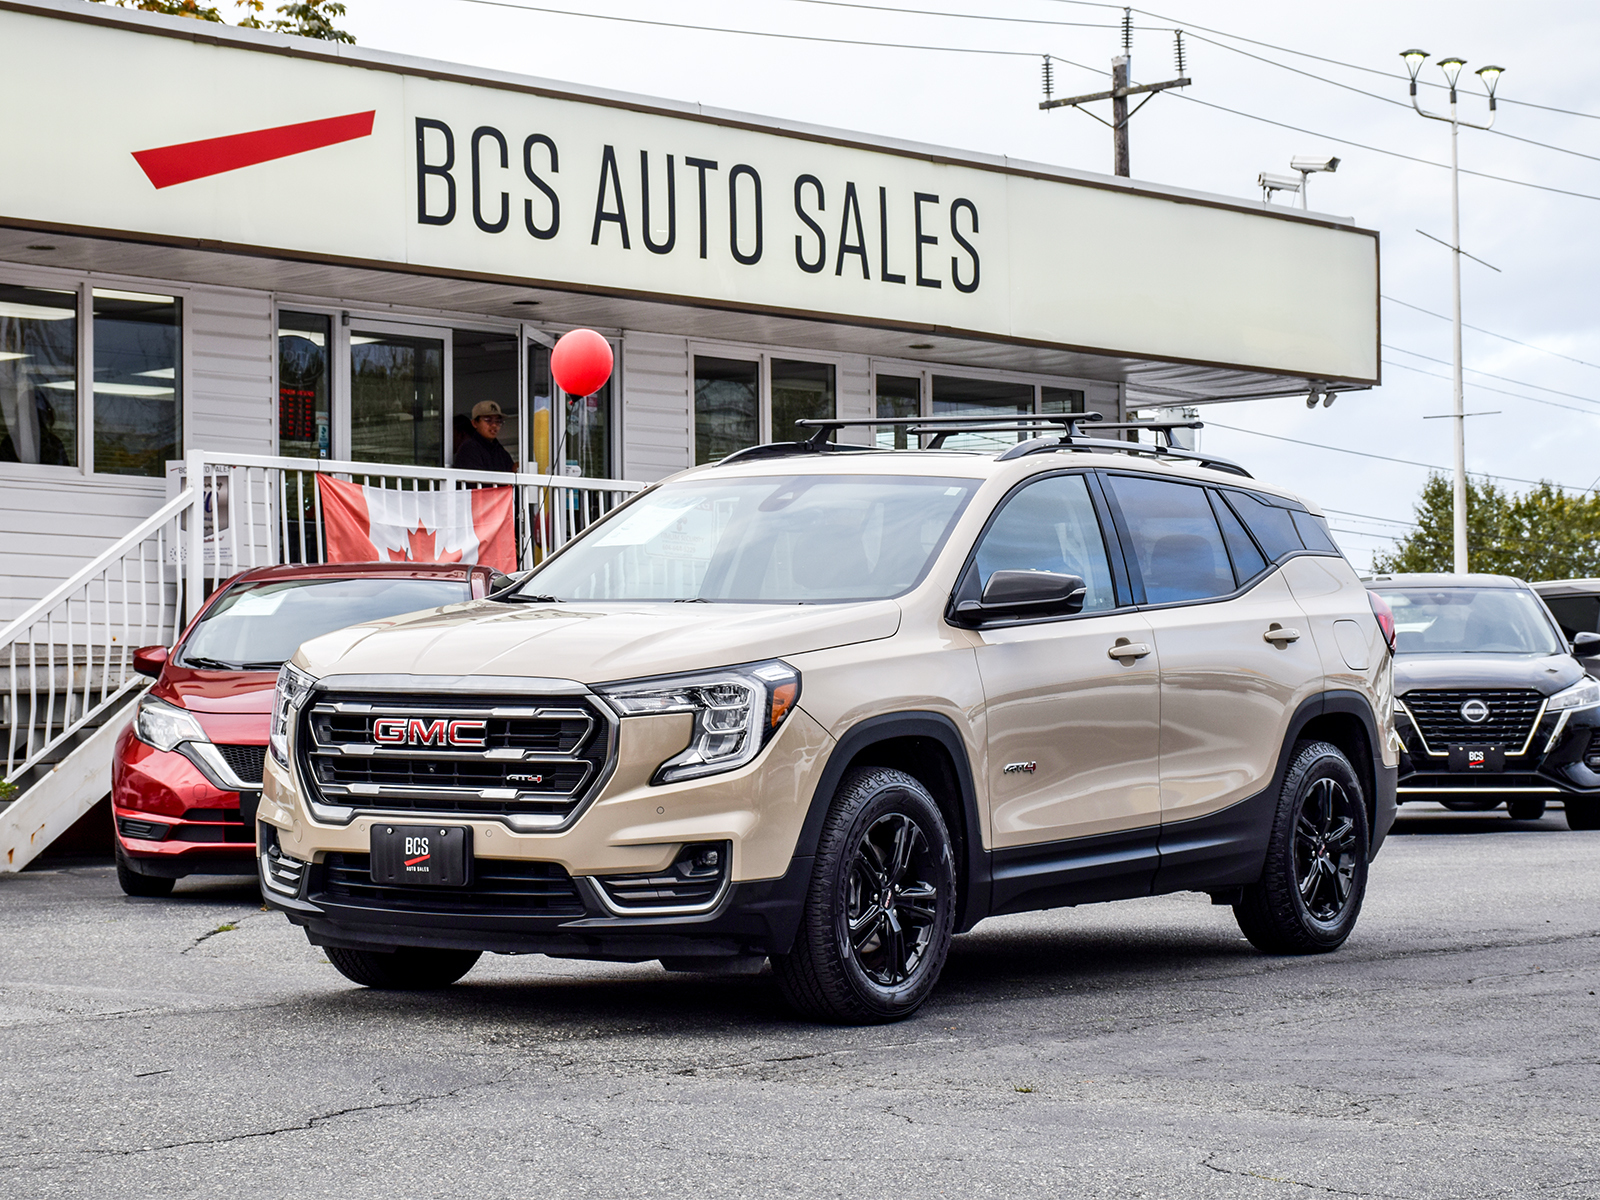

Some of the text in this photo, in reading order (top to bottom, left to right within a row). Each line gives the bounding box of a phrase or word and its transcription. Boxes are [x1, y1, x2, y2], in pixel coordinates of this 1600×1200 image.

[415, 116, 980, 294] BCS AUTO SALES
[373, 718, 487, 747] GMC
[1469, 751, 1484, 761] BCS
[405, 837, 429, 855] BCS
